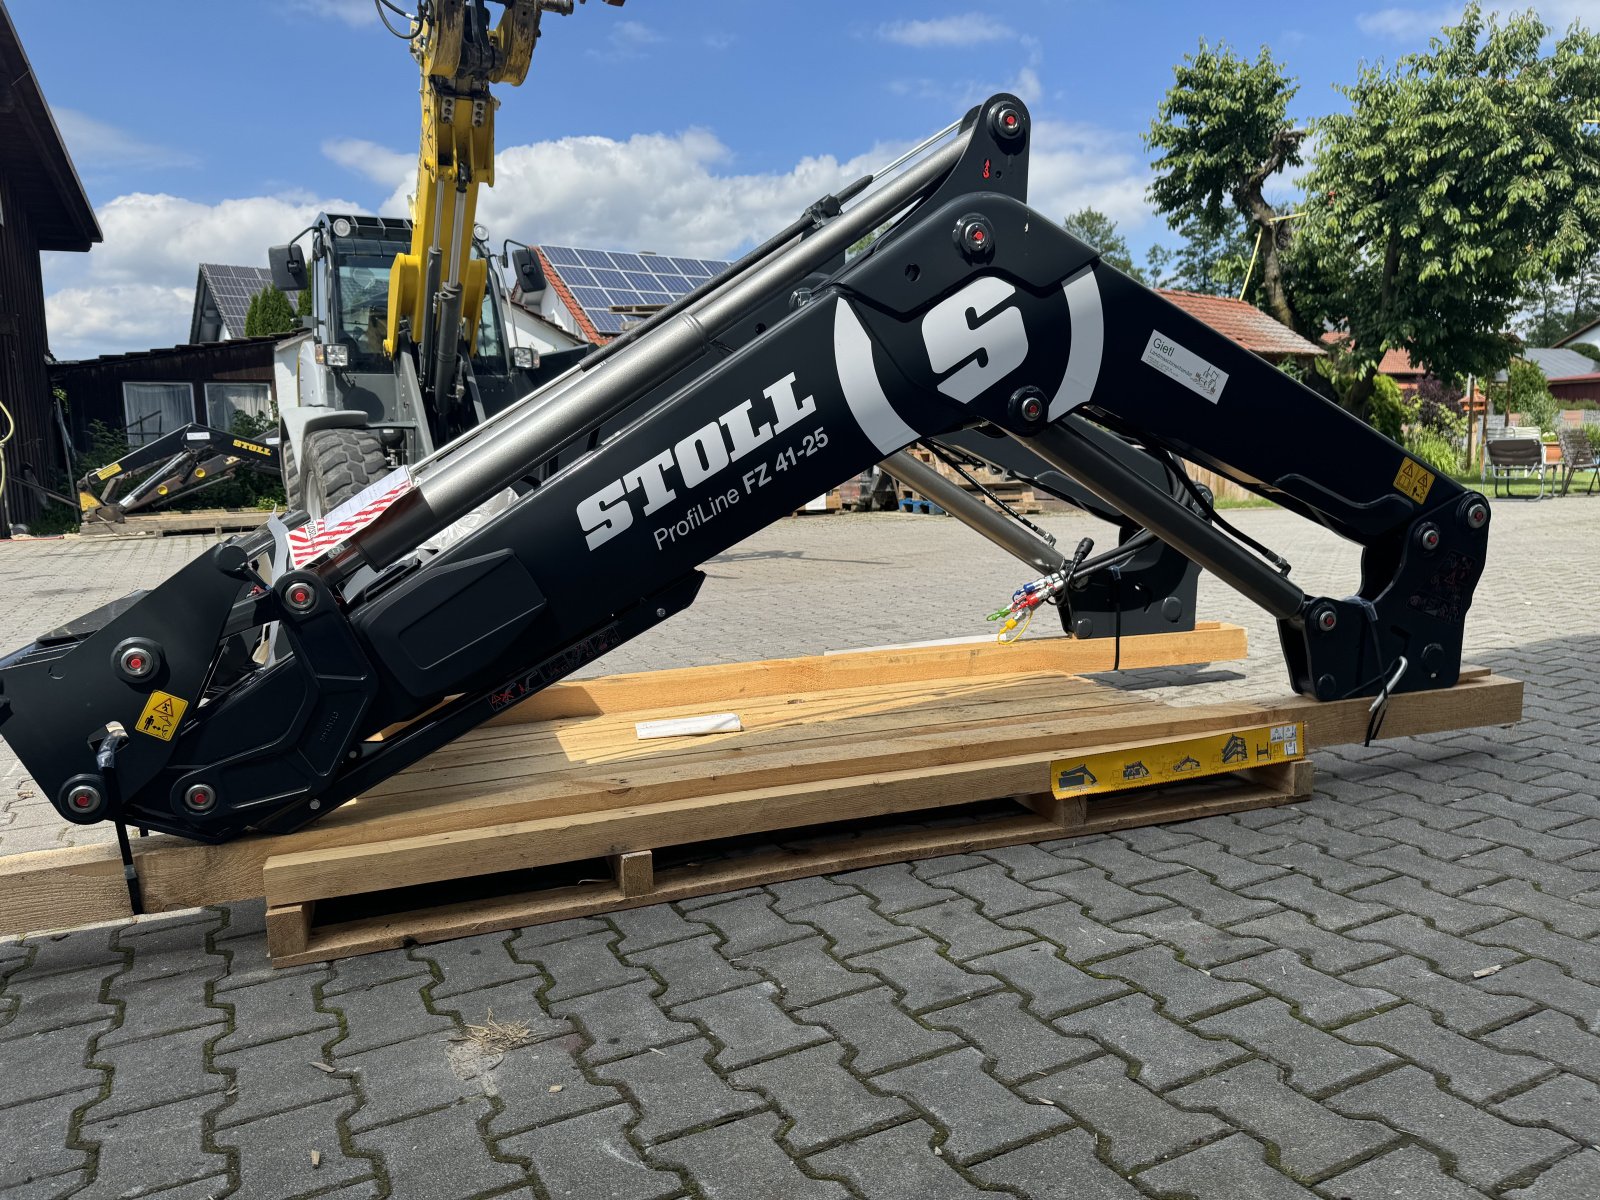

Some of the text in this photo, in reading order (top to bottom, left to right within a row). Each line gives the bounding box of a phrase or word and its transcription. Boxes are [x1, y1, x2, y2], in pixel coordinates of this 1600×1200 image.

[1152, 337, 1175, 357] Gietl
[232, 439, 272, 457] STOLL
[576, 371, 817, 552] STOLL
[653, 426, 829, 551] ProfiLine FZ 41-25
